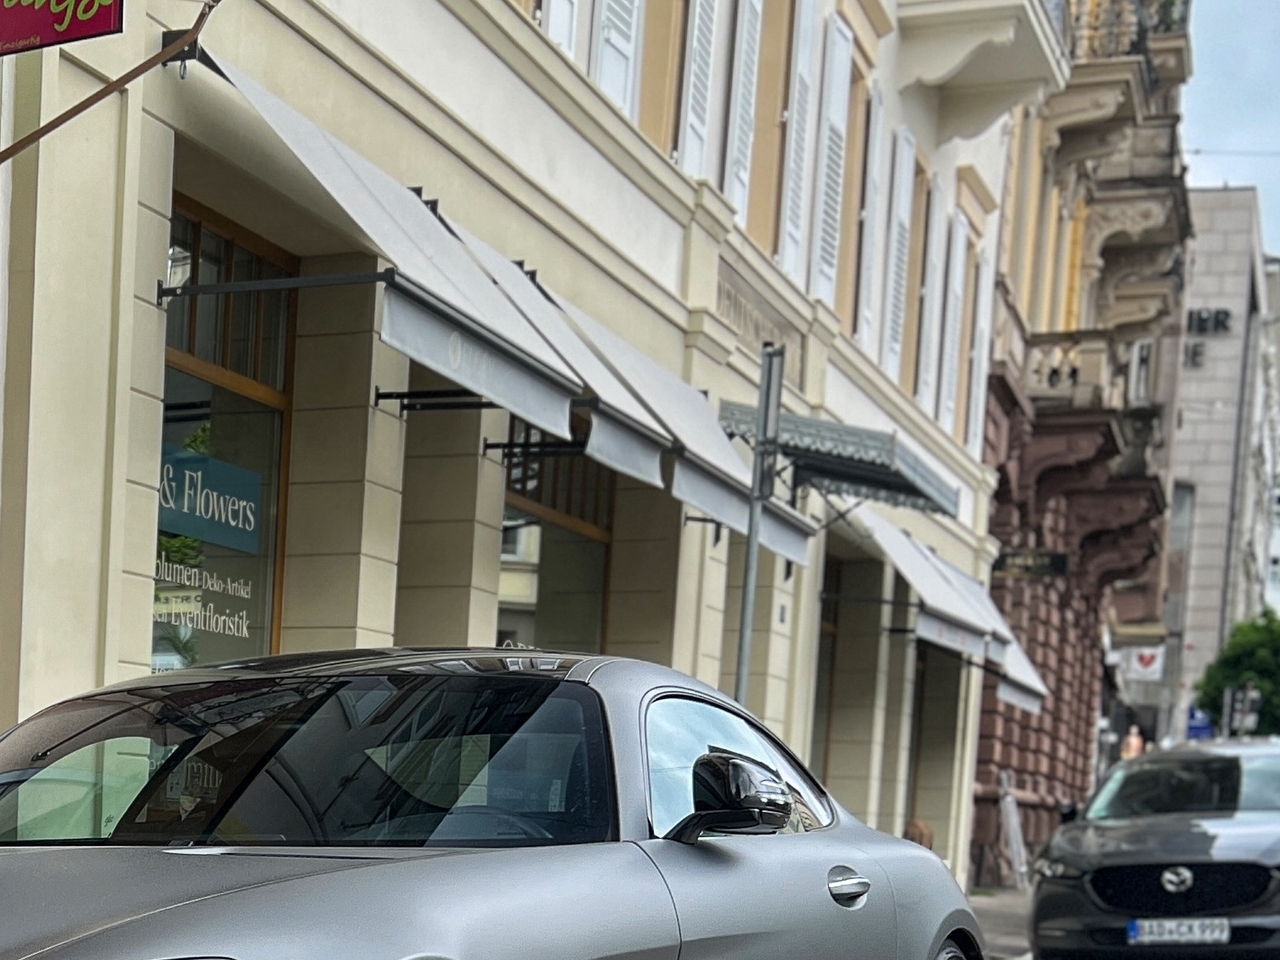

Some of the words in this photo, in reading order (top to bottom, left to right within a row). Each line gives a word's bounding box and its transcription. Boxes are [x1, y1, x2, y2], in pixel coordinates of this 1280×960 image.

[160, 464, 176, 510] &
[182, 470, 255, 531] Flowers
[171, 598, 249, 638] Eventfloristik
